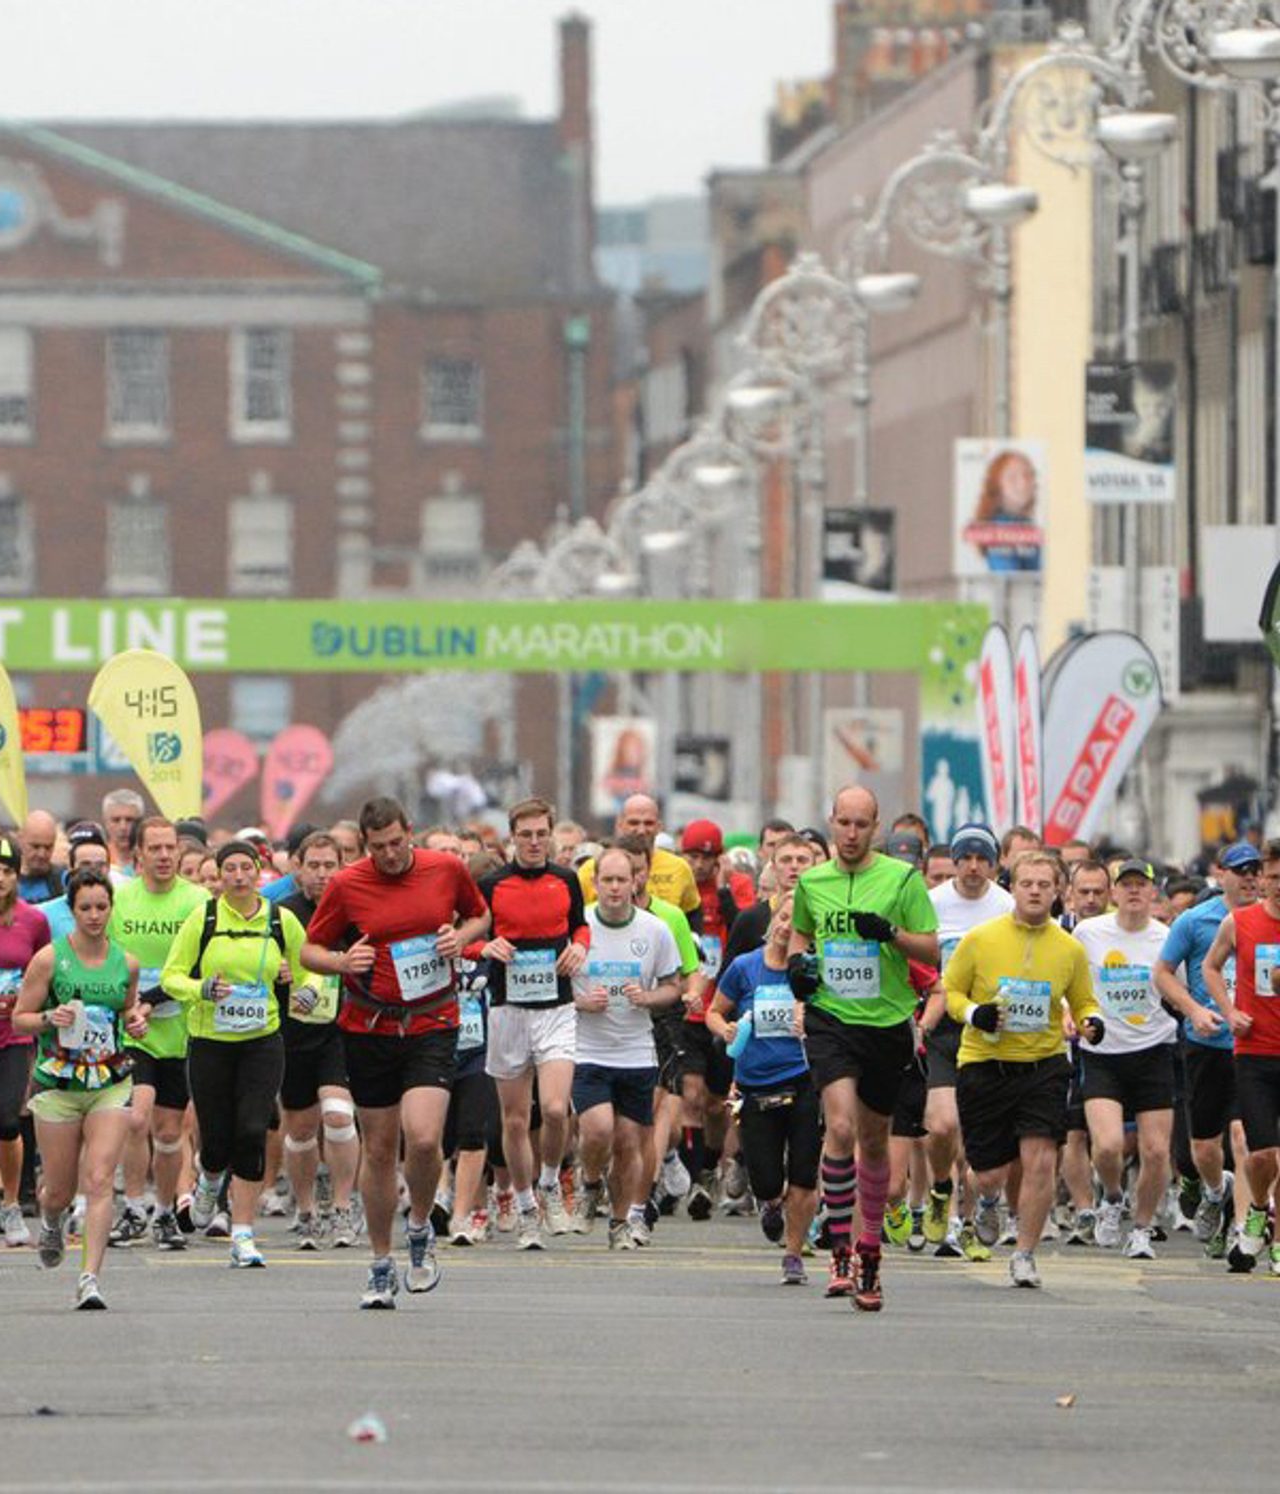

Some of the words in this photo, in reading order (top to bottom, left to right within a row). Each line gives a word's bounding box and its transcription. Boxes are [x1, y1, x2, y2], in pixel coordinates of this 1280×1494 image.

[52, 608, 228, 663] LINE
[312, 620, 477, 657] DUBLIN
[485, 622, 722, 659] MARATHON
[124, 685, 178, 718] 4:15
[1051, 700, 1132, 830] SPAR
[511, 972, 554, 984] 14428
[828, 967, 874, 981] 13018
[219, 1005, 265, 1019] 14408
